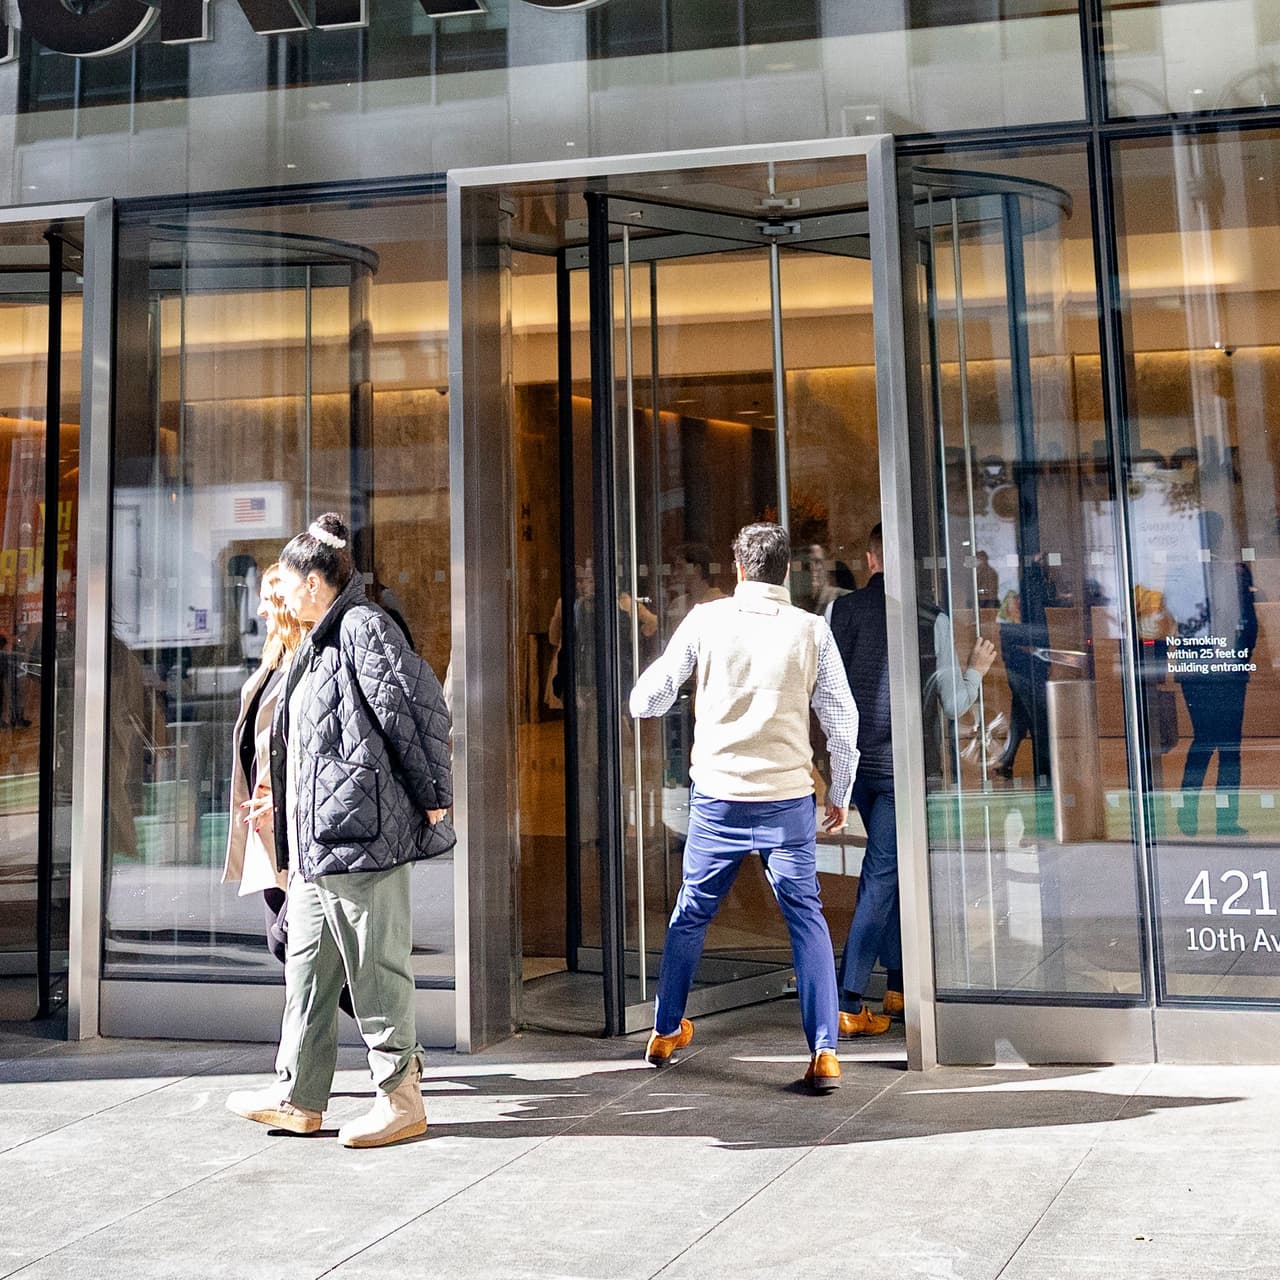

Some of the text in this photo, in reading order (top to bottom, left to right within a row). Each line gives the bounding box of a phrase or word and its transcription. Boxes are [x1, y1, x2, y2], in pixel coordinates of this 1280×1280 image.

[1166, 635, 1227, 647] No smoking
[1166, 647, 1249, 659] within 25 feet of
[1167, 661, 1257, 674] building entrance
[1184, 869, 1277, 915] 421
[1186, 927, 1245, 951] 10th
